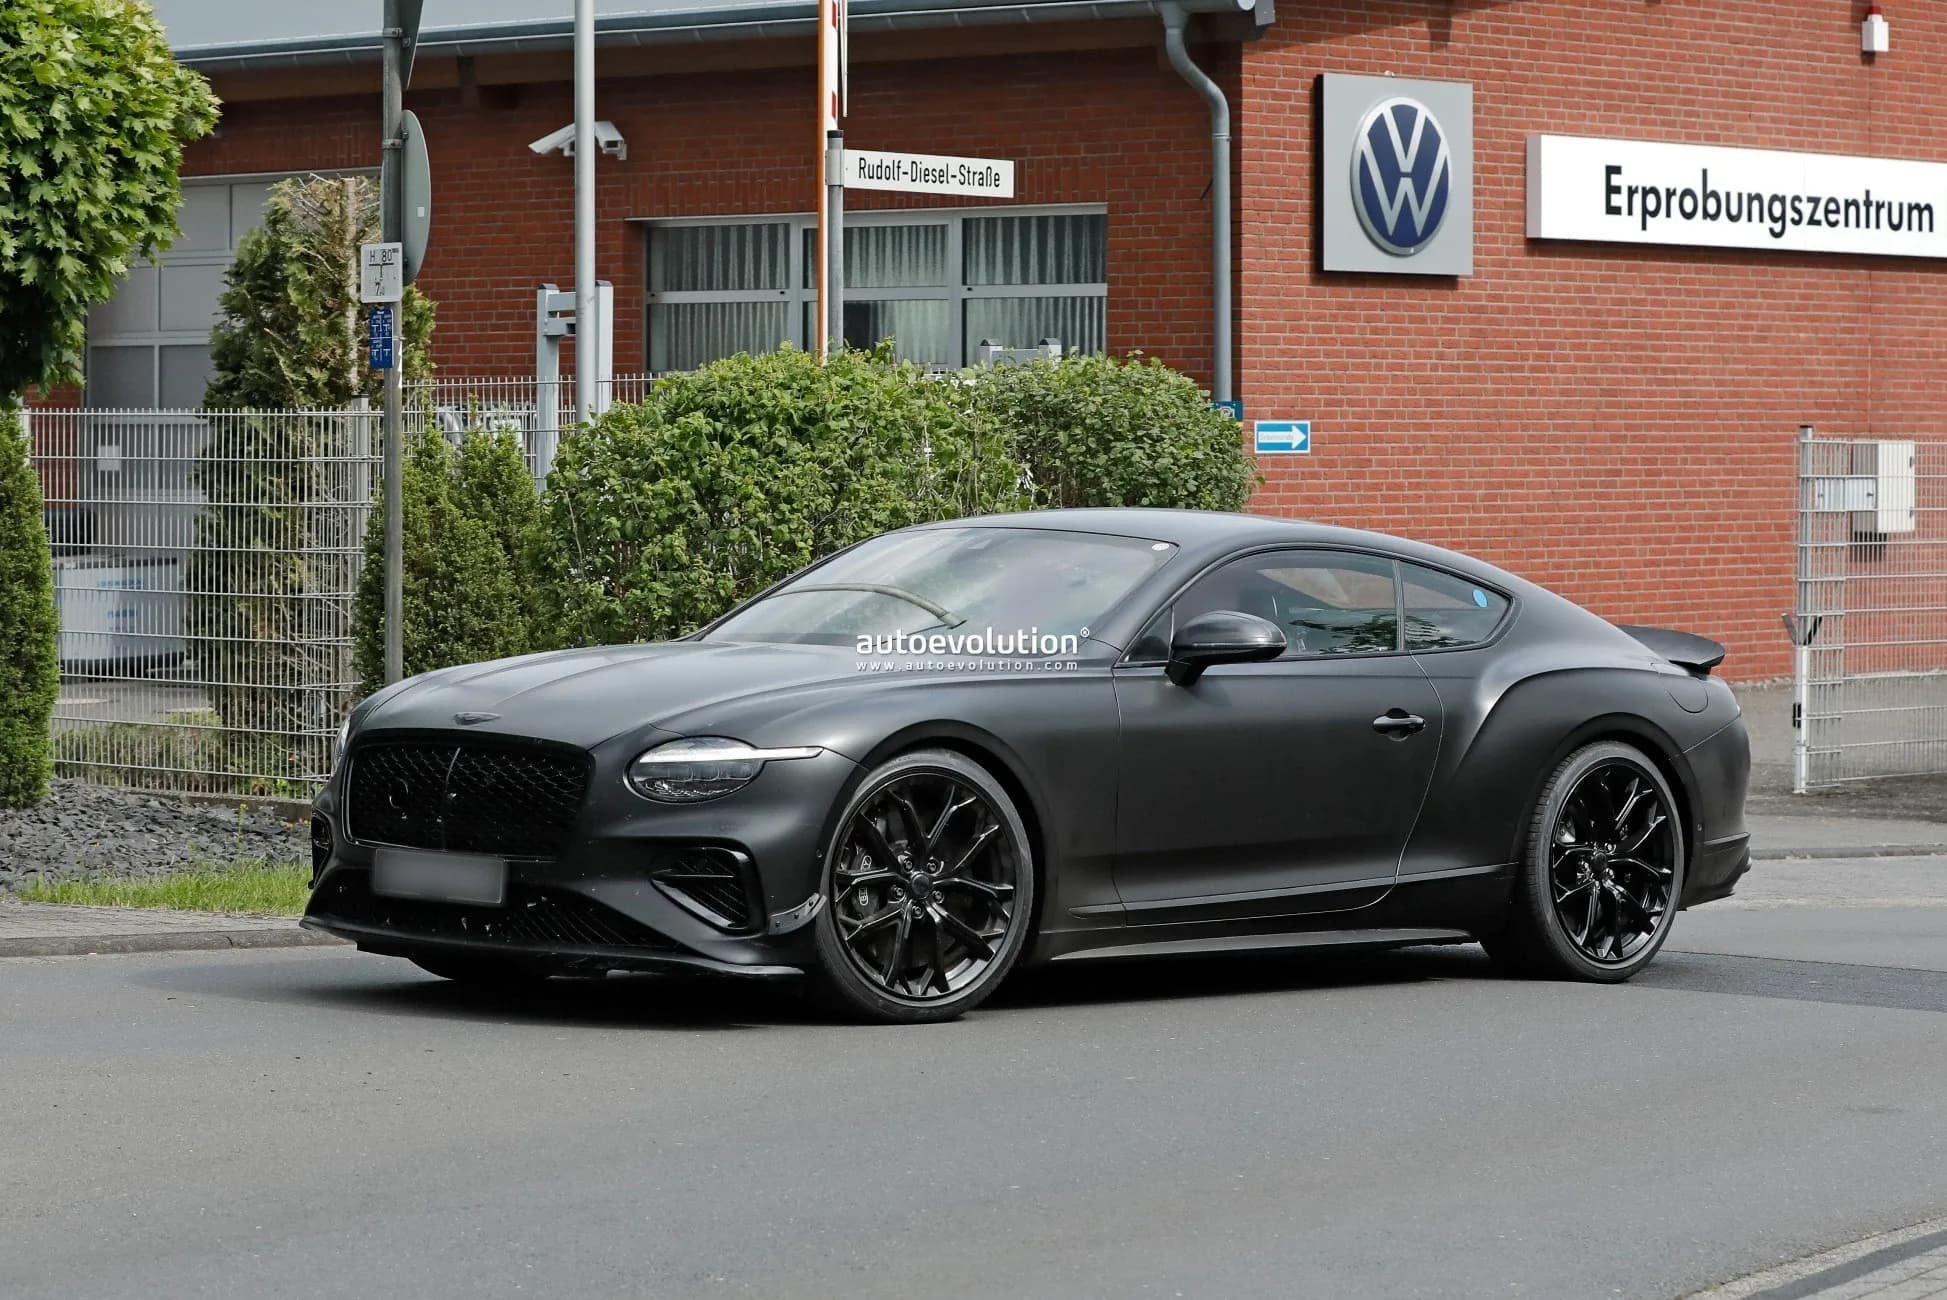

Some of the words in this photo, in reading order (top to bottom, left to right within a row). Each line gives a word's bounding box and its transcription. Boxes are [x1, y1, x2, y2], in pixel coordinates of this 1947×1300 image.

[858, 157, 1001, 188] Rudolf-Diesel-Straße
[1357, 99, 1449, 238] VW
[1604, 164, 1934, 239] Erprobungszentrum
